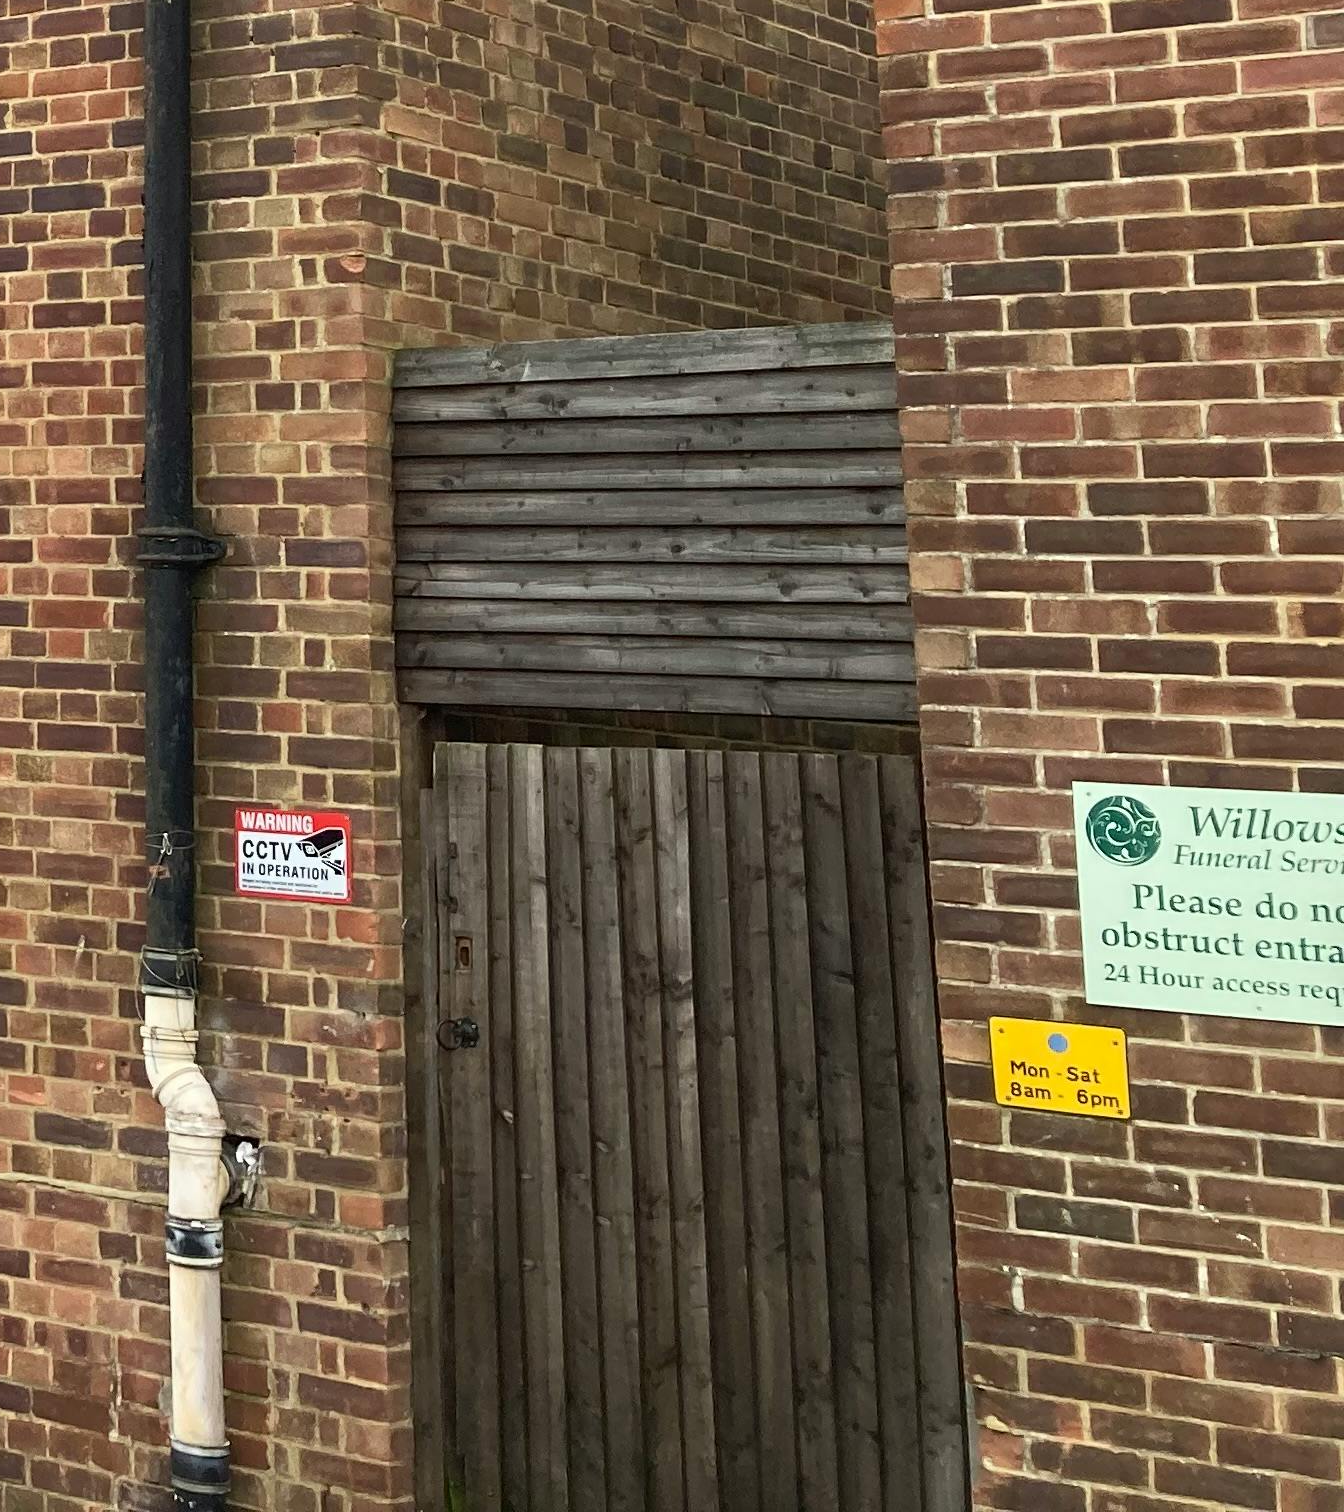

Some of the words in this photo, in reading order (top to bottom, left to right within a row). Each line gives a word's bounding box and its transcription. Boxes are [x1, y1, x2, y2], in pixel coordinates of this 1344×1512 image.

[240, 810, 314, 834] WARNING
[242, 839, 292, 861] CCTV
[1173, 843, 1273, 871] Funeral
[242, 861, 255, 875] IN
[258, 863, 329, 881] OPERATION
[1131, 883, 1243, 917] Please
[1255, 892, 1299, 921] do
[1101, 921, 1246, 957] obstruct
[1103, 963, 1131, 983] 24
[1137, 965, 1205, 989] Hour
[1212, 976, 1291, 997] access
[1010, 1060, 1050, 1079] Mon
[1066, 1067, 1102, 1084] Sat
[1010, 1081, 1052, 1100] 8am
[1076, 1089, 1120, 1108] 6pm
